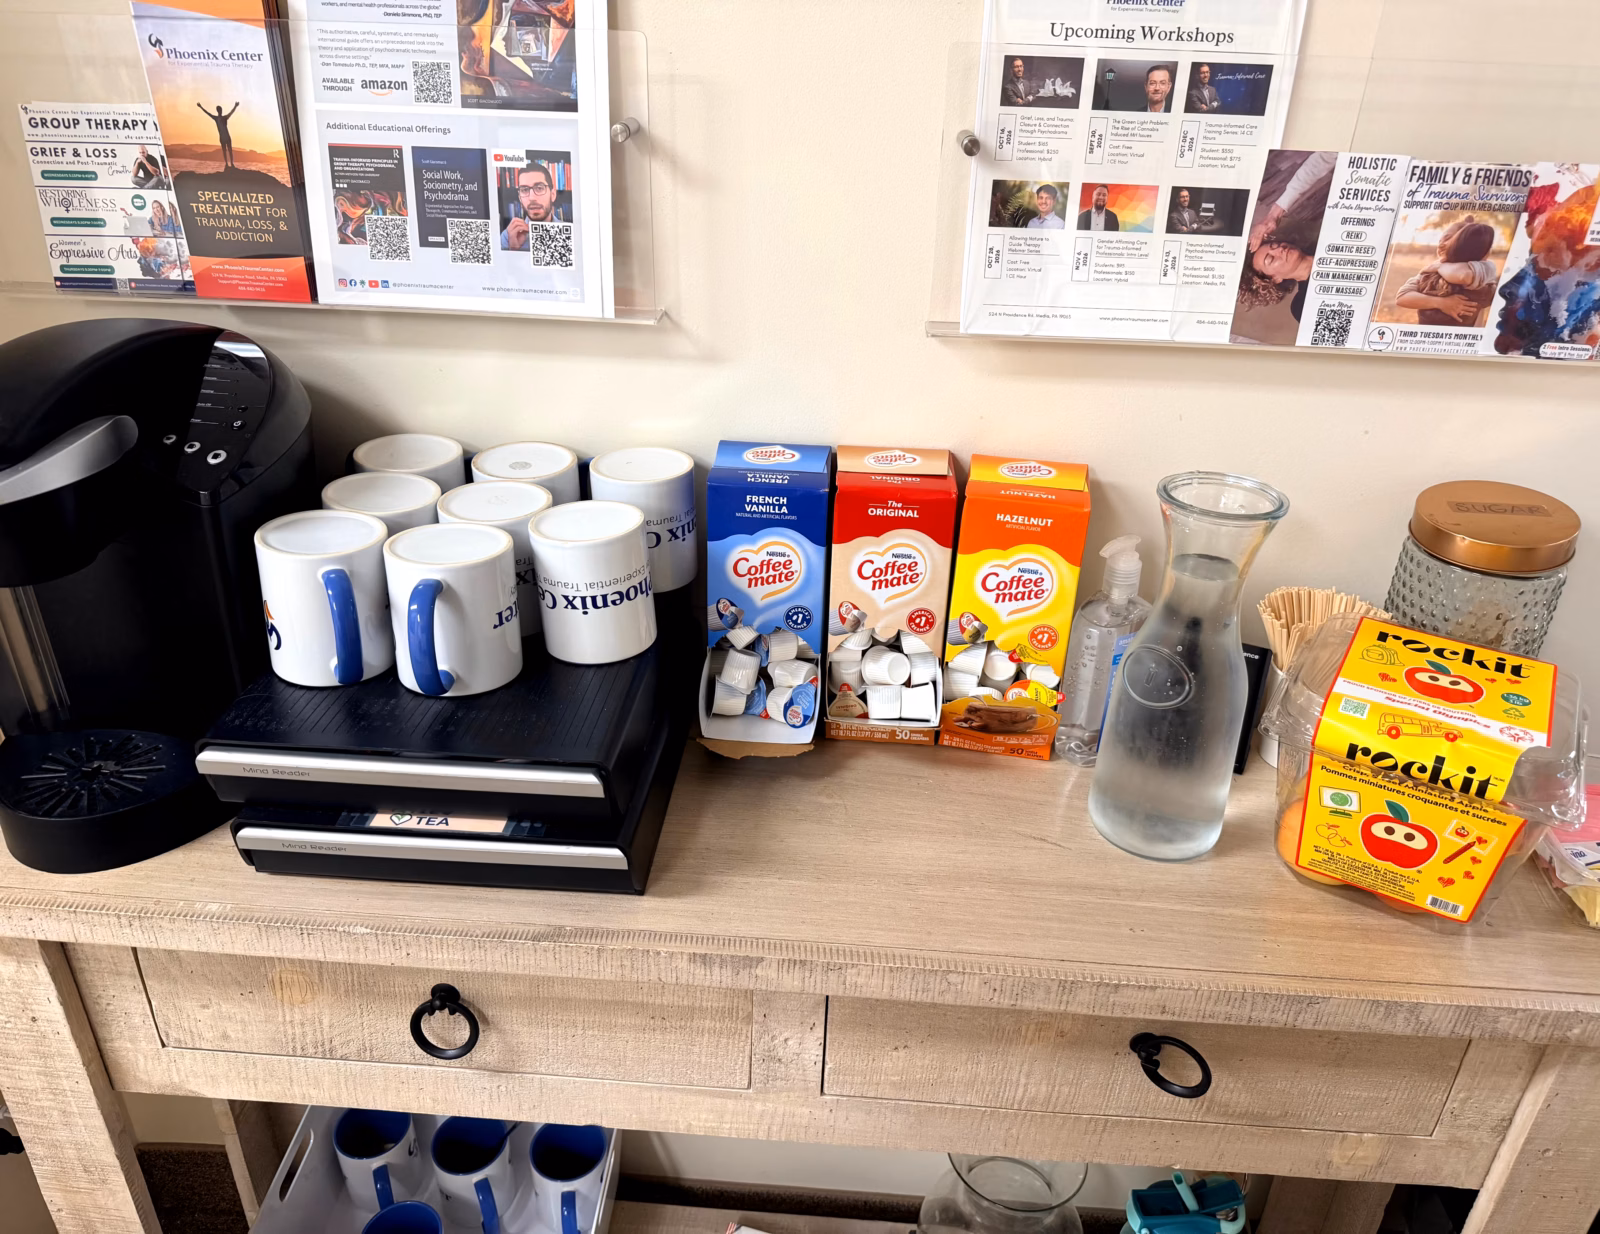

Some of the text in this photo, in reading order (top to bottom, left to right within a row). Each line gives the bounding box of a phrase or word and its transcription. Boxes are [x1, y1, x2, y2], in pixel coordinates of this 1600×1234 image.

[1050, 23, 1234, 46] Upcoming Workshops
[166, 48, 263, 62] Phoenix Center
[361, 79, 408, 91] amazon
[28, 117, 147, 130] GROUP THERAPY
[326, 122, 451, 135] Additional Educational Offerings
[1179, 130, 1188, 158] OCT-DEC
[30, 147, 117, 158] GRIEF & LOSS
[393, 149, 400, 158] R
[504, 155, 524, 163] YouTube
[1348, 156, 1397, 171] HOLISTIC
[108, 166, 132, 176] Growth
[423, 170, 463, 181] Social Work,
[1409, 166, 1532, 187] FAMILY & FRIENDS
[1346, 170, 1391, 187] Somatic
[423, 180, 477, 192] Sociometry, and
[38, 189, 87, 198] RESTORING
[198, 191, 273, 204] SPECIALIZED
[424, 191, 468, 201] Psychodrama
[1339, 188, 1391, 202] SERVICES
[1407, 183, 1527, 203] of Trauma Survivors
[41, 197, 116, 208] WHOLENESS
[1404, 201, 1433, 210] SUPPORT
[1434, 202, 1458, 210] GROUP
[1478, 203, 1491, 211] MEB
[1493, 204, 1522, 212] CARROLL
[190, 203, 288, 217] TREATMENT FOR
[195, 217, 288, 231] TRAUMA, LOSS, &
[1341, 217, 1375, 227] OFFERINGS
[216, 231, 273, 242] ADDICTION
[50, 243, 138, 263] Expressive Arts
[1327, 245, 1353, 253] SOMATIC
[1318, 258, 1377, 268] SELF-ACUPRESSURE
[1335, 287, 1362, 295] MASSAGE
[1454, 333, 1482, 341] MONTHLY
[746, 495, 787, 504] FRENCH
[1000, 490, 1056, 499] HAZELNUT
[745, 504, 788, 514] VANILLA
[868, 508, 919, 518] ORIGINAL
[1455, 502, 1545, 514] SUGAR
[646, 514, 682, 526] Trauma
[996, 514, 1053, 526] HAZELNUT
[732, 557, 793, 577] Coffee
[857, 559, 918, 580] Coffee
[584, 565, 646, 591] Experiential
[747, 570, 795, 588] mate
[871, 572, 919, 590] mate
[981, 572, 1045, 592] Coffee
[543, 577, 582, 592] Trauma
[995, 589, 1045, 603] mate
[788, 608, 810, 619] AMERICA'S
[792, 614, 802, 623] #1
[911, 610, 933, 622] AMERICA'S
[787, 619, 807, 629] CREAMER
[915, 616, 926, 626] #1
[910, 623, 929, 633] CREAMER
[1034, 627, 1057, 639] AMERICA'S
[1031, 638, 1052, 648] CREAMER
[1037, 634, 1048, 643] #1
[1376, 631, 1536, 680] rockit
[1343, 679, 1366, 688] PROUD
[1366, 686, 1397, 698] SPONSOR
[1442, 706, 1476, 718] SOUTENIR
[1384, 696, 1491, 729] Special Olympics
[895, 728, 910, 739] 50
[1346, 742, 1498, 801] rockit
[1321, 765, 1507, 827] Pommes miniatures croquantes et sucrées
[1457, 800, 1489, 813] Apple
[416, 816, 449, 826] TEA
